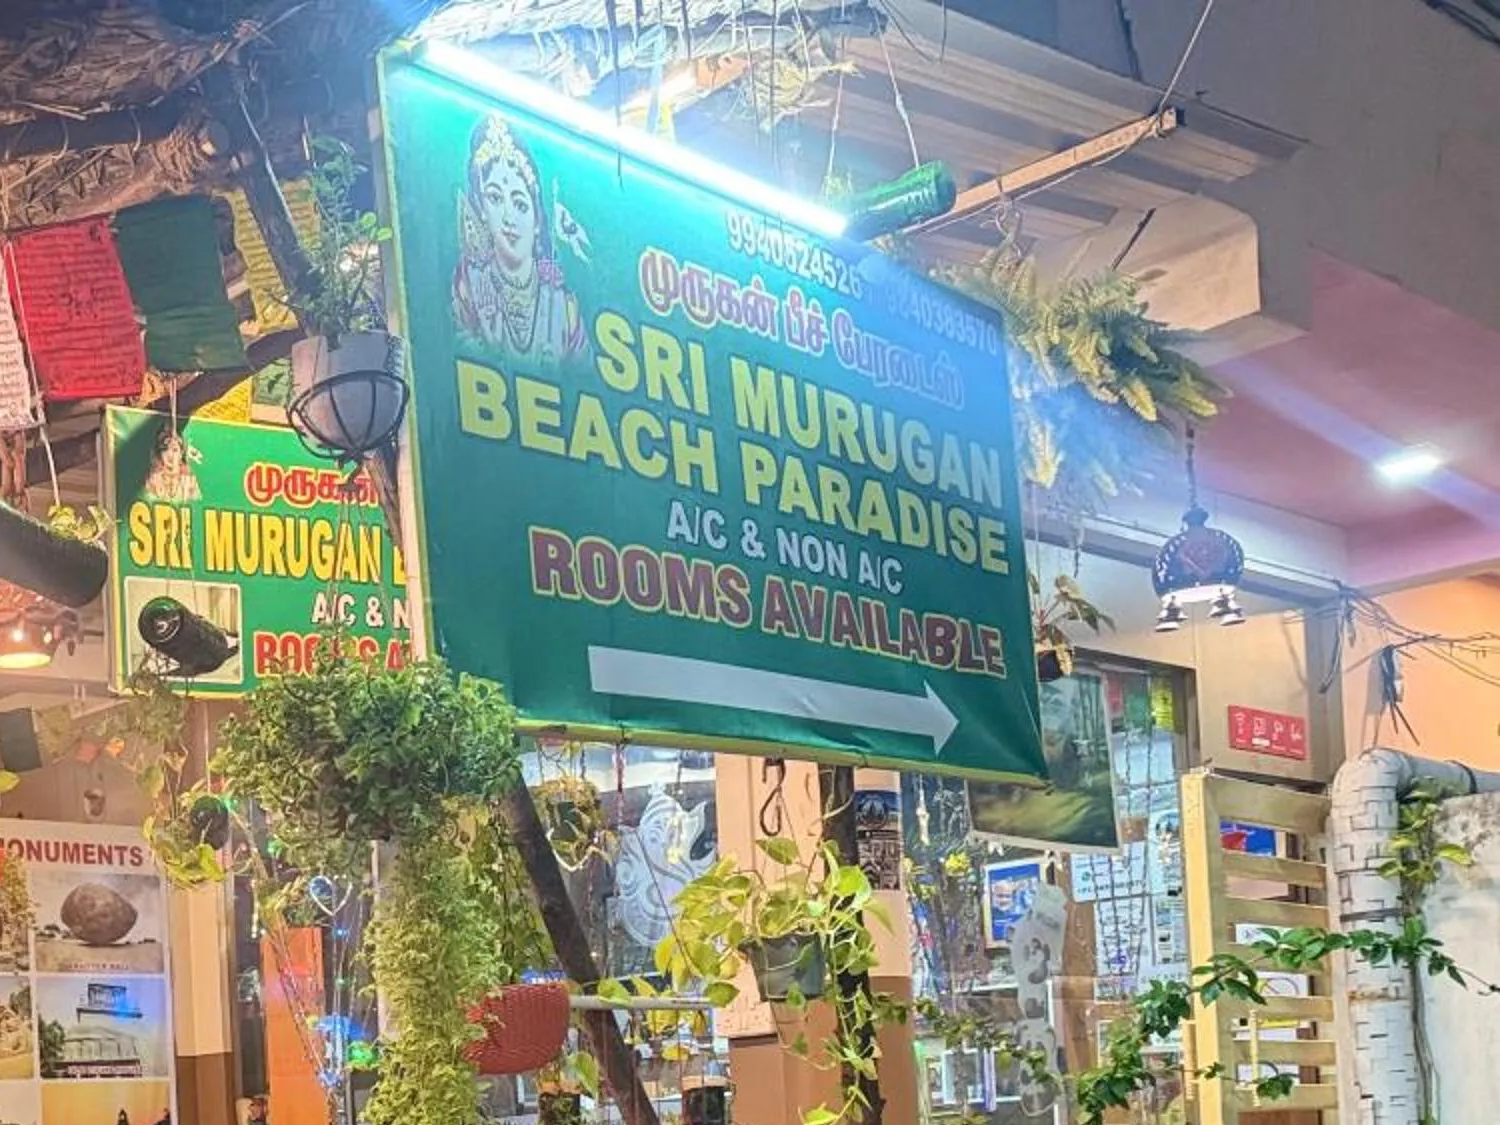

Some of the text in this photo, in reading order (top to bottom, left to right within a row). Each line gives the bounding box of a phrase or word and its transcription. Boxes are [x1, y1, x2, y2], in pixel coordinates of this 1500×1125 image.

[638, 246, 779, 342] முருகன்
[595, 311, 1003, 508] SRI MURUGAN
[456, 358, 1010, 575] BEACH PARADISE
[128, 500, 193, 571] SRI
[204, 509, 381, 584] MURUGAN
[666, 501, 727, 551] A/C
[741, 520, 766, 561] &
[778, 528, 848, 580] NON
[366, 596, 384, 628] &
[527, 526, 1007, 678] ROOMS AVAILABLE
